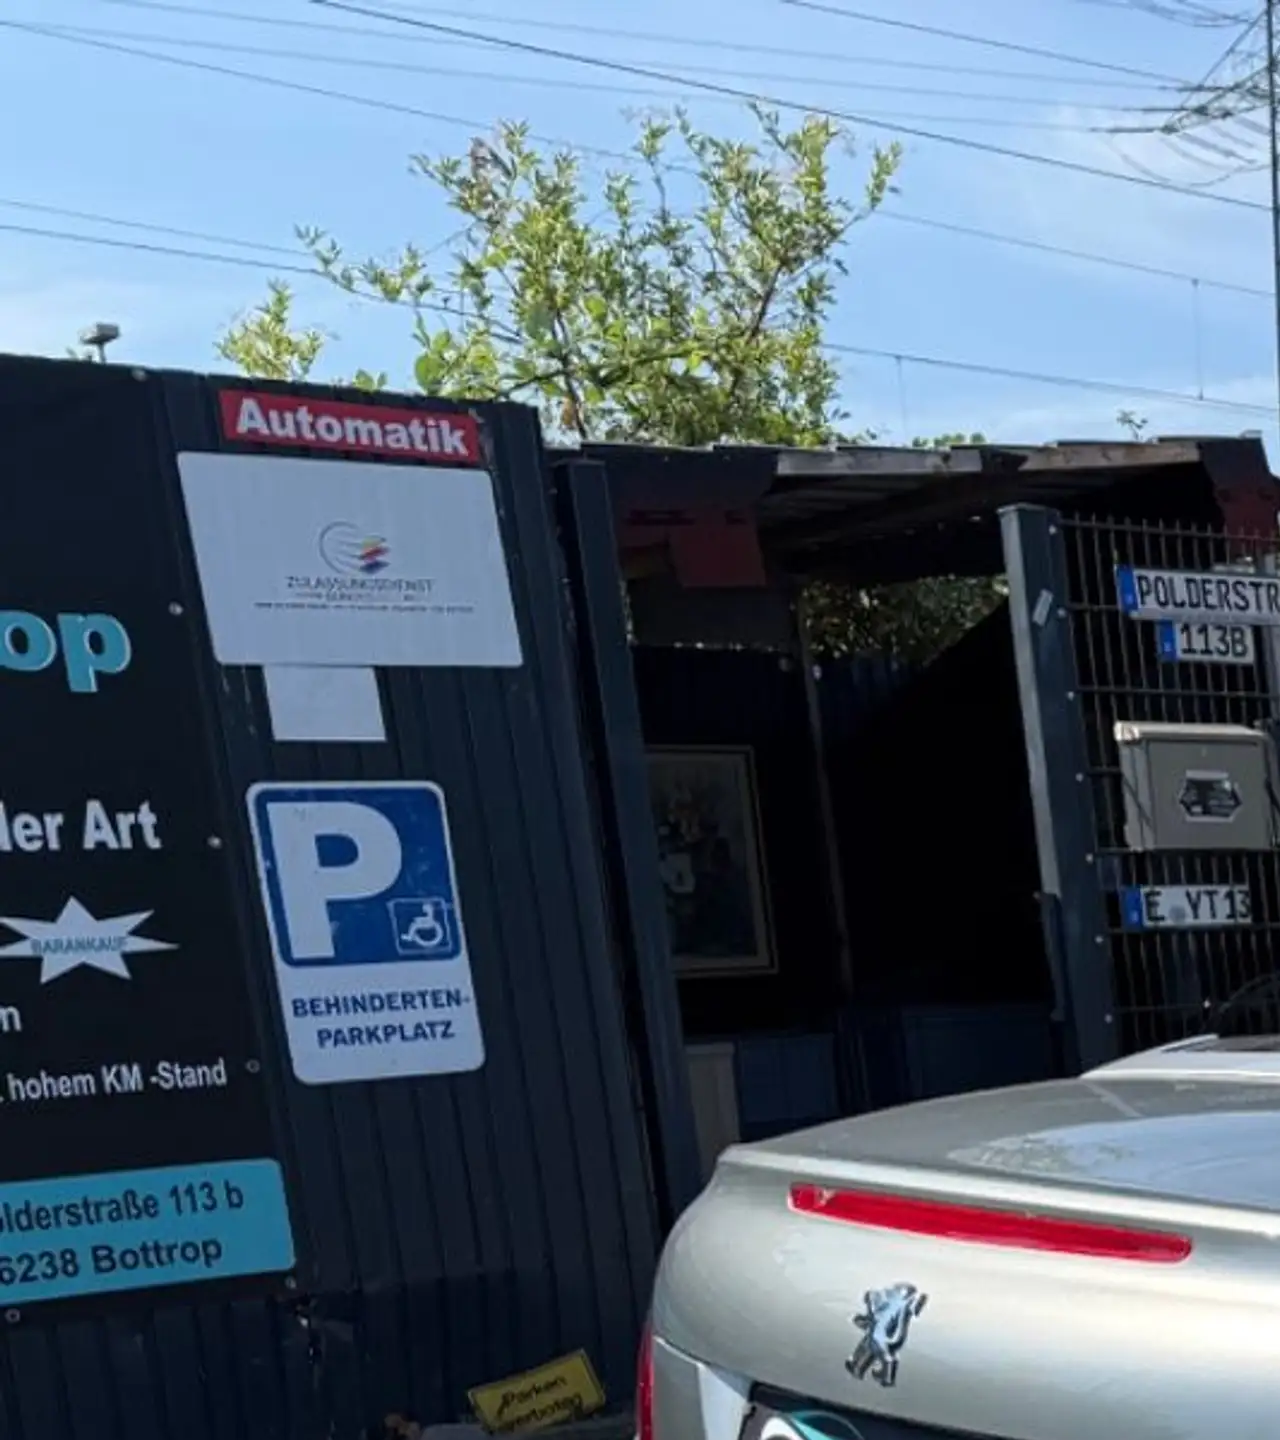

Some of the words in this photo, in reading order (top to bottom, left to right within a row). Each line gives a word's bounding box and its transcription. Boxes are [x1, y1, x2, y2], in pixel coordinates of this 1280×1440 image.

[237, 397, 469, 456] Automatik
[1180, 622, 1248, 657] 113B
[83, 799, 162, 850] Art
[267, 801, 402, 959] P
[292, 989, 471, 1018] BEHINDERTEN-
[316, 1020, 455, 1049] PARKPLATZ
[8, 1070, 96, 1101] hohem
[101, 1063, 143, 1095] KM
[169, 1181, 218, 1216] 113
[223, 1180, 244, 1209] b
[91, 1238, 222, 1273] Bottrop
